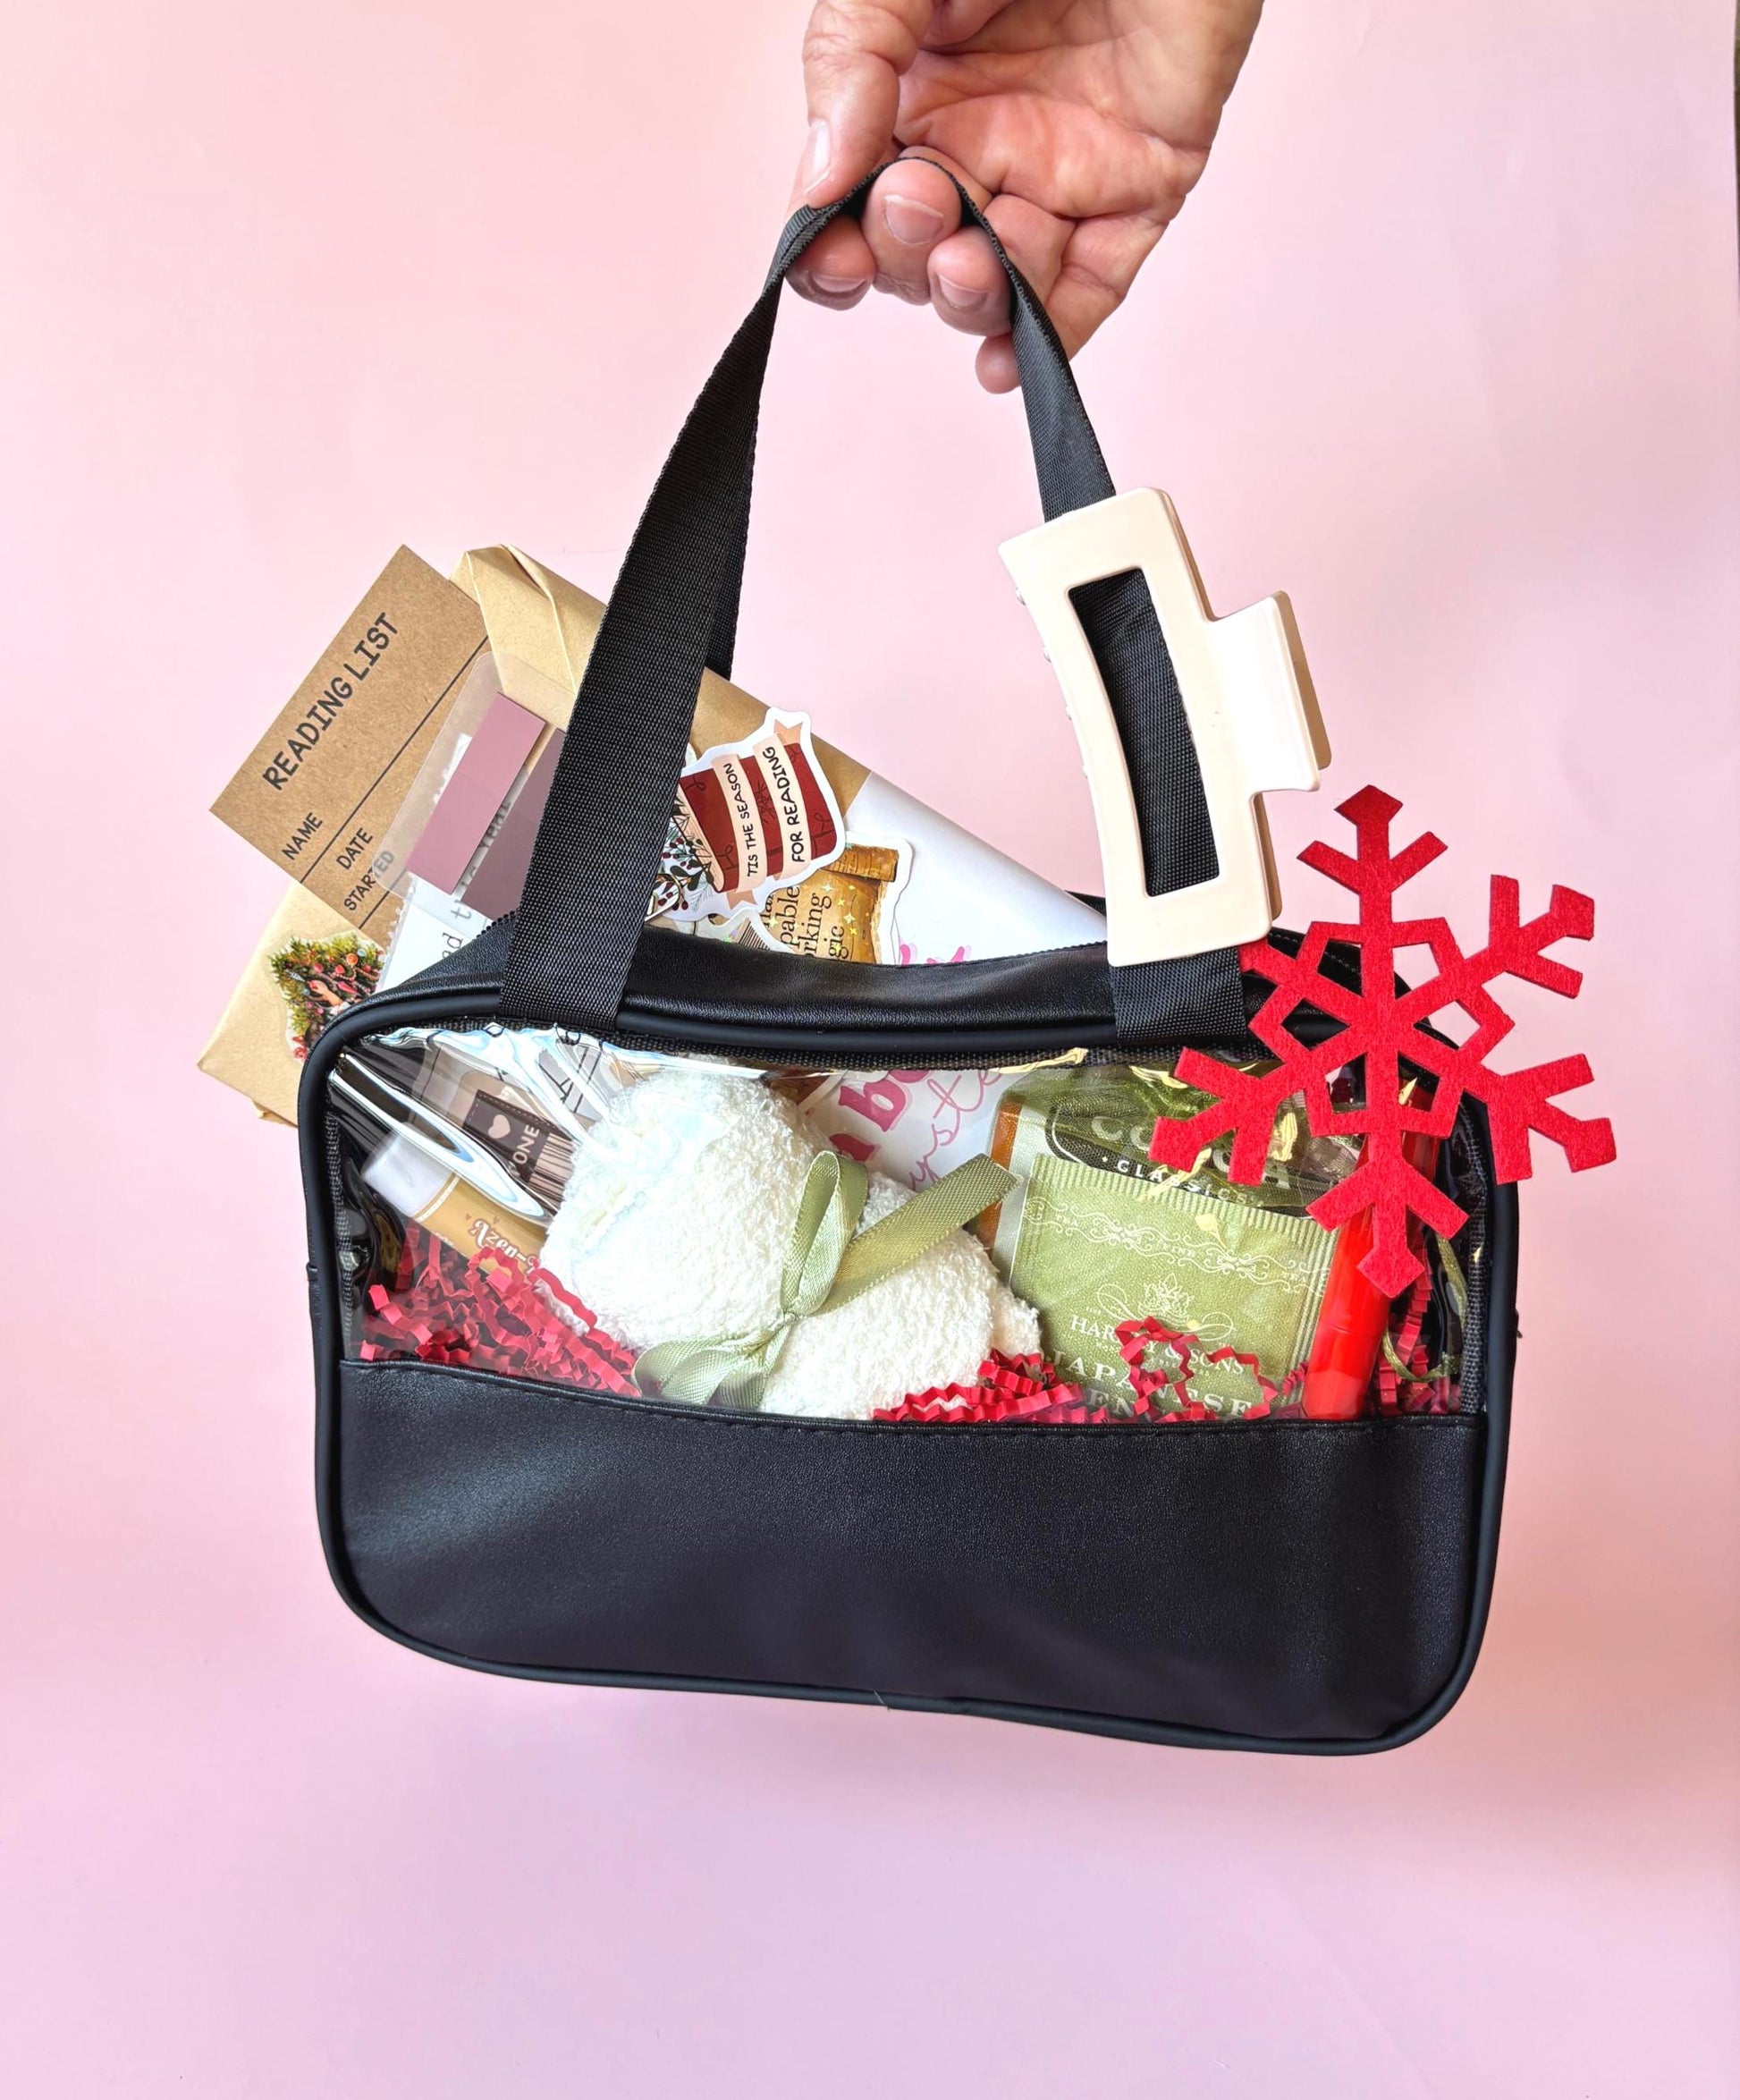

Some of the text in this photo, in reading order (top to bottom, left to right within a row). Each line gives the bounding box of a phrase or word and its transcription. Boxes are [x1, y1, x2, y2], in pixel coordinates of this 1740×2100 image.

[261, 612, 399, 791] READING LIST
[723, 763, 749, 818] SEASON
[762, 746, 805, 862] FOR READING
[282, 812, 323, 860] NAME
[336, 827, 374, 870] DATE
[742, 823, 756, 851] THE
[343, 850, 394, 911] STARTED
[775, 885, 800, 948] pable
[798, 893, 832, 957] rking
[824, 926, 849, 960] gic
[1069, 1315, 1156, 1353] HARY
